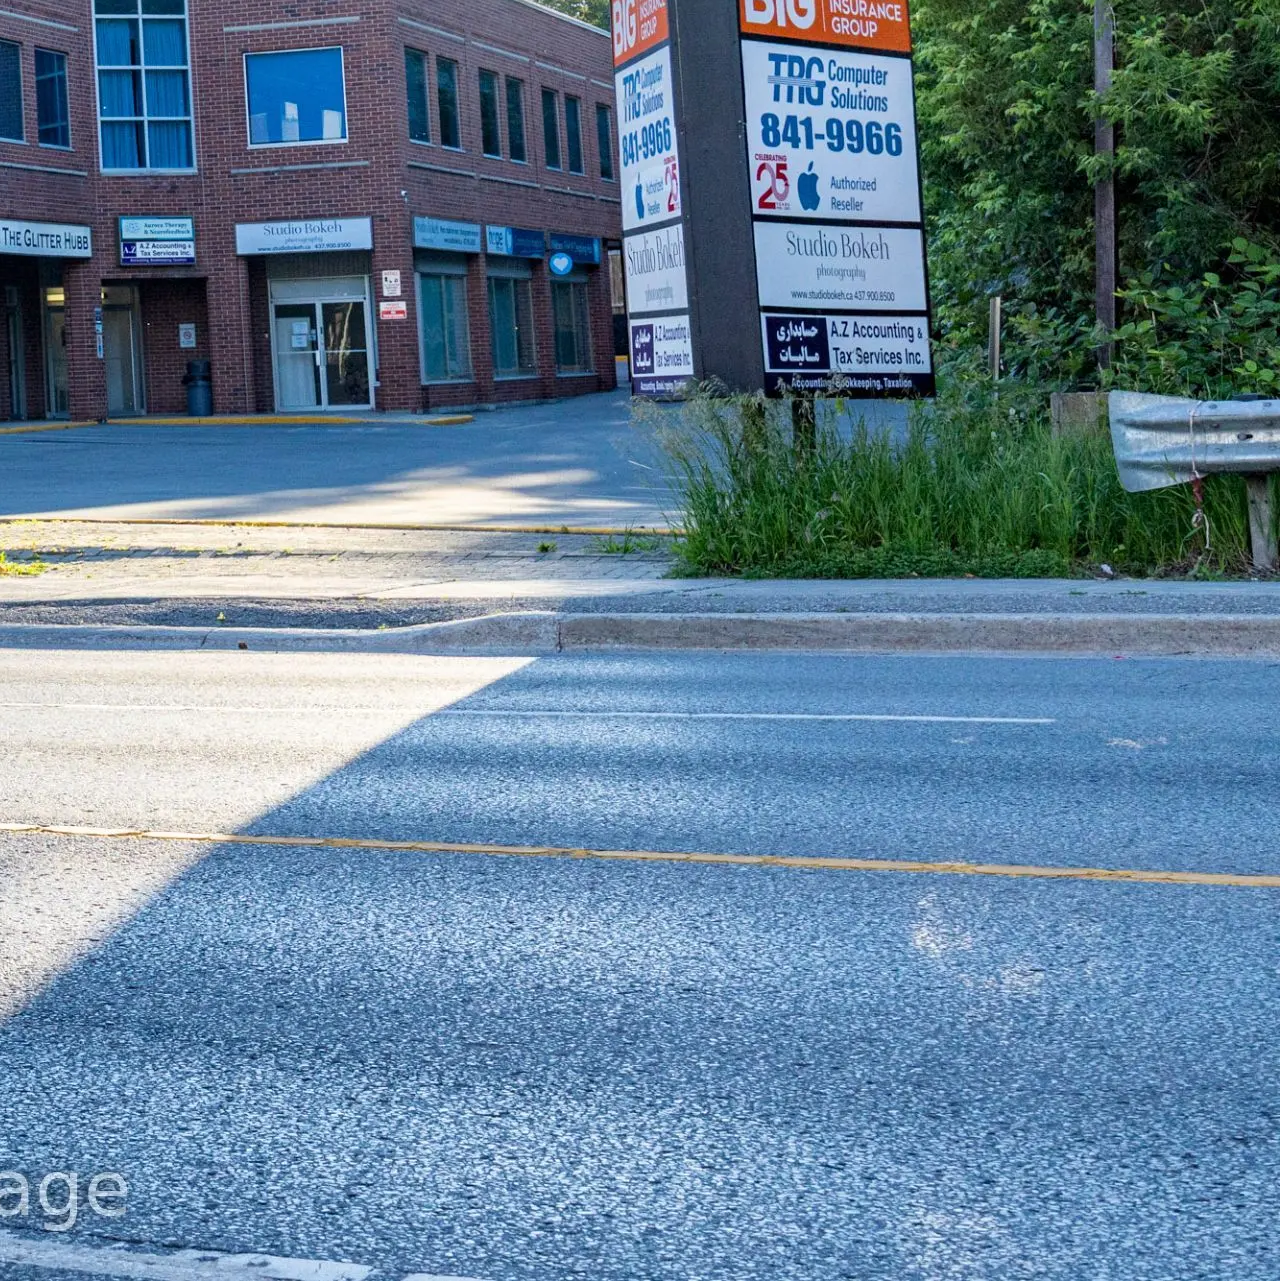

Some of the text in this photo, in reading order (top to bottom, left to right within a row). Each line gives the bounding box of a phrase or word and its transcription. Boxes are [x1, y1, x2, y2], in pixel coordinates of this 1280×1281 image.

[640, 15, 657, 41] GROUP
[831, 16, 878, 38] GROUP
[768, 52, 889, 106] TRG Computer
[642, 90, 664, 116] Solutions
[830, 86, 889, 113] Solutions
[622, 116, 672, 168] 841-9966
[760, 112, 903, 157] 841-9966
[754, 153, 787, 162] CELEBRATING
[756, 162, 790, 209] 25
[830, 176, 877, 191] Authorized
[831, 197, 864, 212] Reseller
[2, 227, 89, 250] THE GLITTER HUBB
[263, 220, 342, 236] Studio Bokeh
[627, 236, 656, 277] Studio
[656, 227, 685, 271] Bokeh
[786, 230, 890, 260] Studio Bokeh
[816, 264, 866, 282] photography
[791, 289, 895, 302] www.studiobokeh.ca 437.900.8500
[831, 321, 923, 343] A.Z Accounting &
[832, 347, 925, 365] Tax Services Inc.
